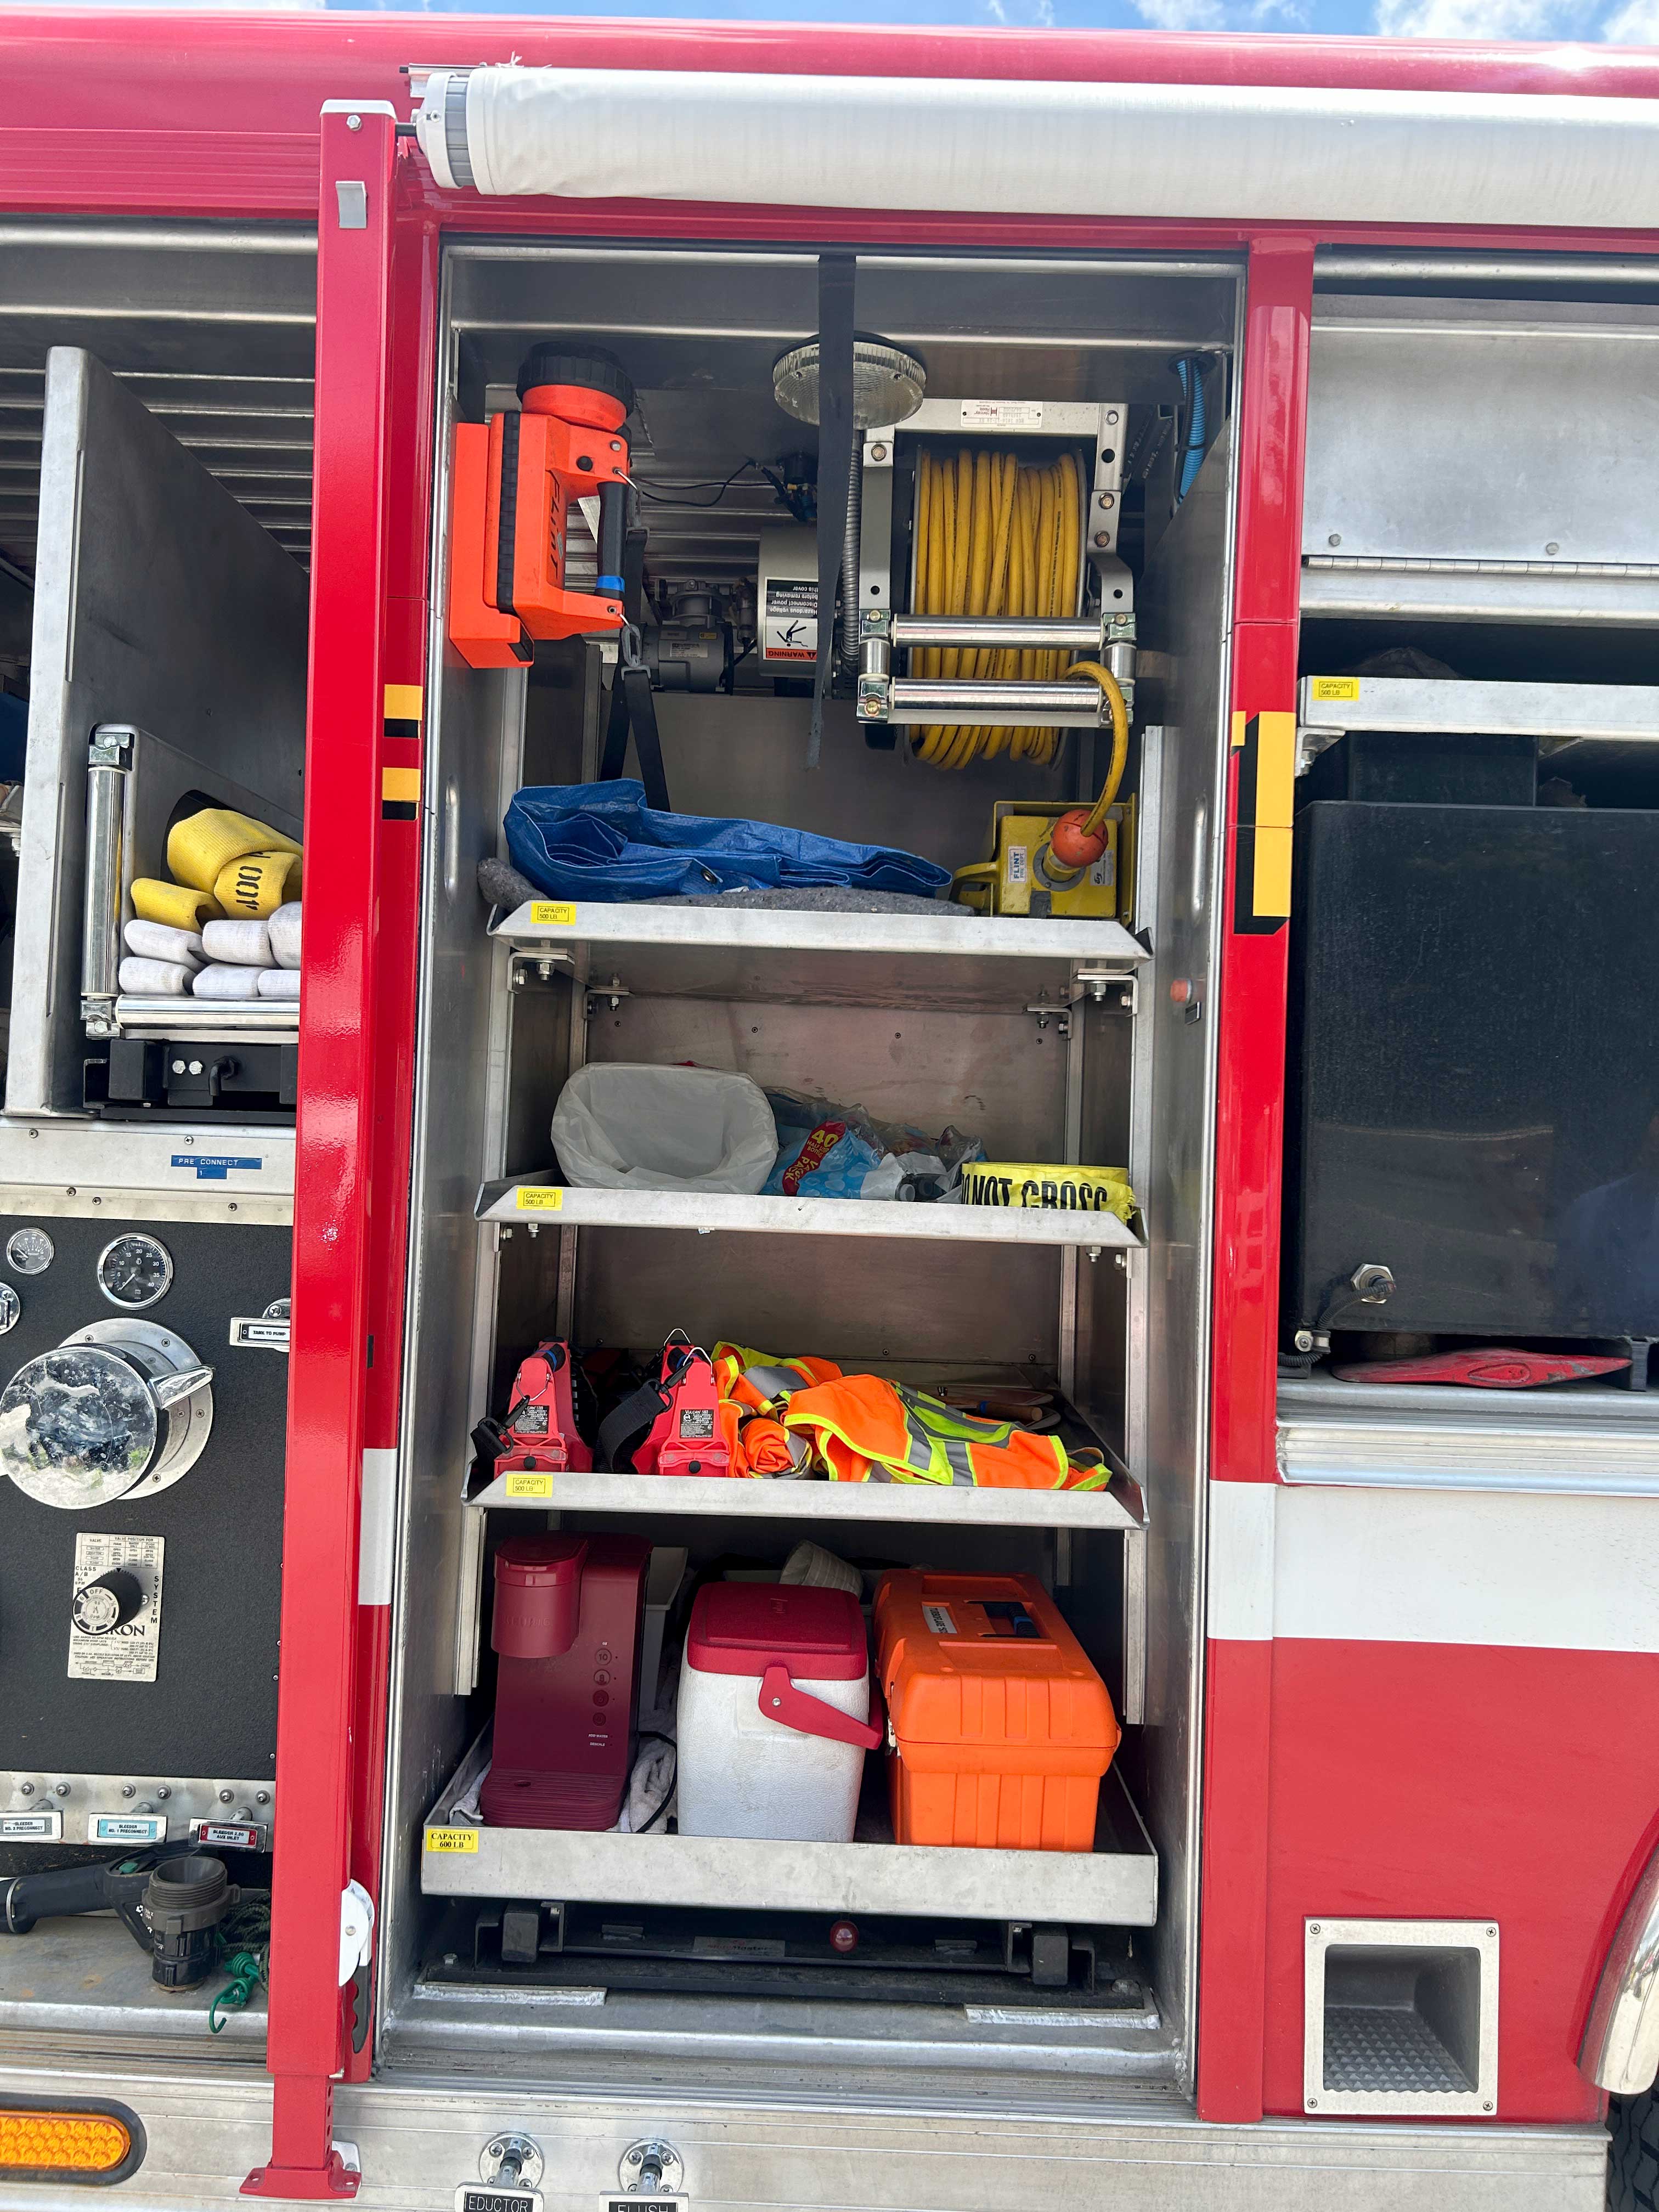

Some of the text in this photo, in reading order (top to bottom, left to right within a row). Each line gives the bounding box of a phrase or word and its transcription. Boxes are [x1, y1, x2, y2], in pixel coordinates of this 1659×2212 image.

[811, 1130, 839, 1148] 40
[785, 1156, 810, 1181] PACK
[972, 1175, 1013, 1207] NOT
[150, 1576, 159, 1624] SYSTEM
[431, 1832, 473, 1841] CAPACITY
[469, 2196, 528, 2212] EDUCTOR
